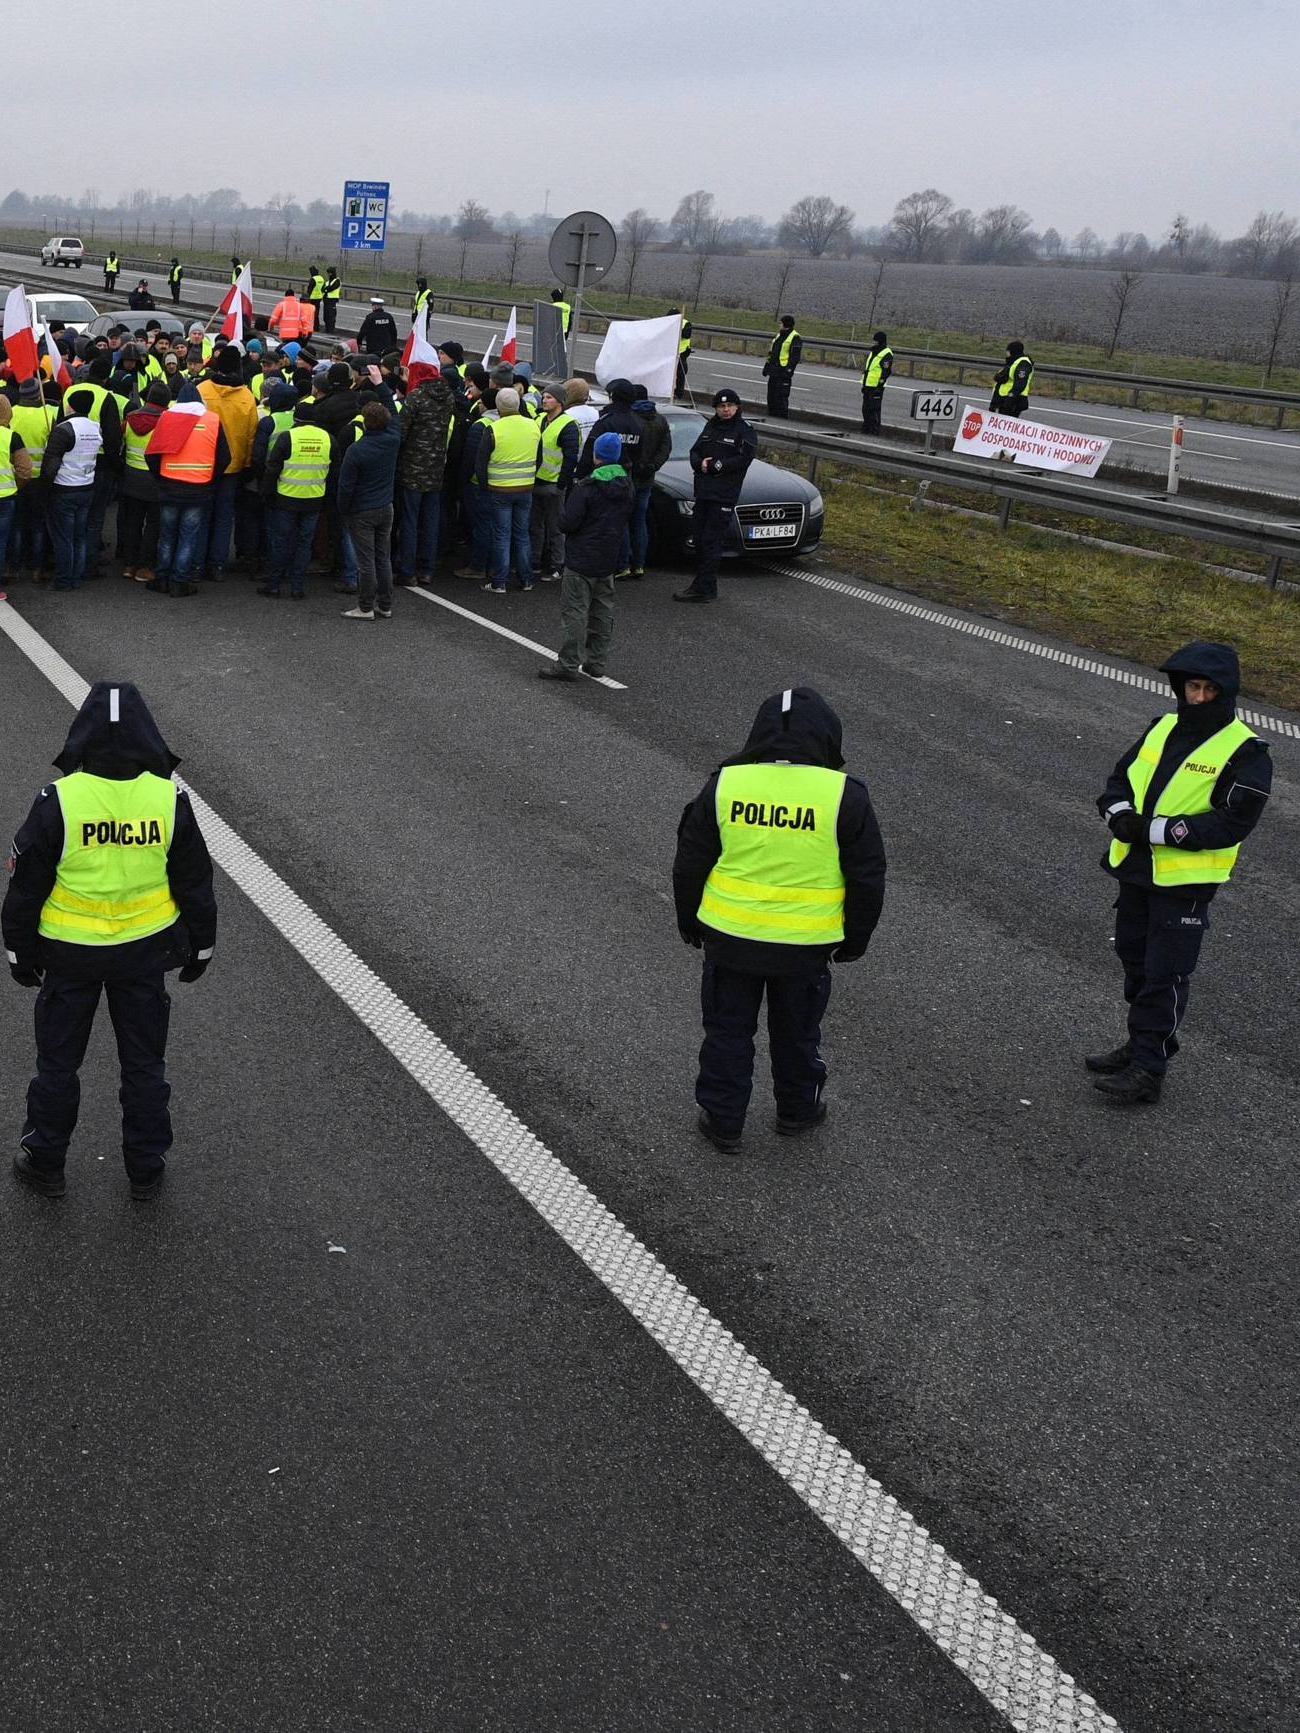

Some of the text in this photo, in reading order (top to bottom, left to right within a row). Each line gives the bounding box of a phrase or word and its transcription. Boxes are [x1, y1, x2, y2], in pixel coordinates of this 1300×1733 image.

[369, 203, 384, 212] WC
[348, 223, 359, 237] P
[354, 241, 371, 249] 2 km
[920, 398, 954, 417] 446
[963, 420, 981, 432] STOP
[988, 416, 1103, 452] PACYFIKACJI RODZINNYCH
[981, 431, 1047, 456] GOSPODARSTW
[754, 525, 794, 538] PKA LF84
[1184, 762, 1217, 775] POLICJA
[730, 800, 816, 831] POLICJA
[82, 820, 162, 846] POLICJA
